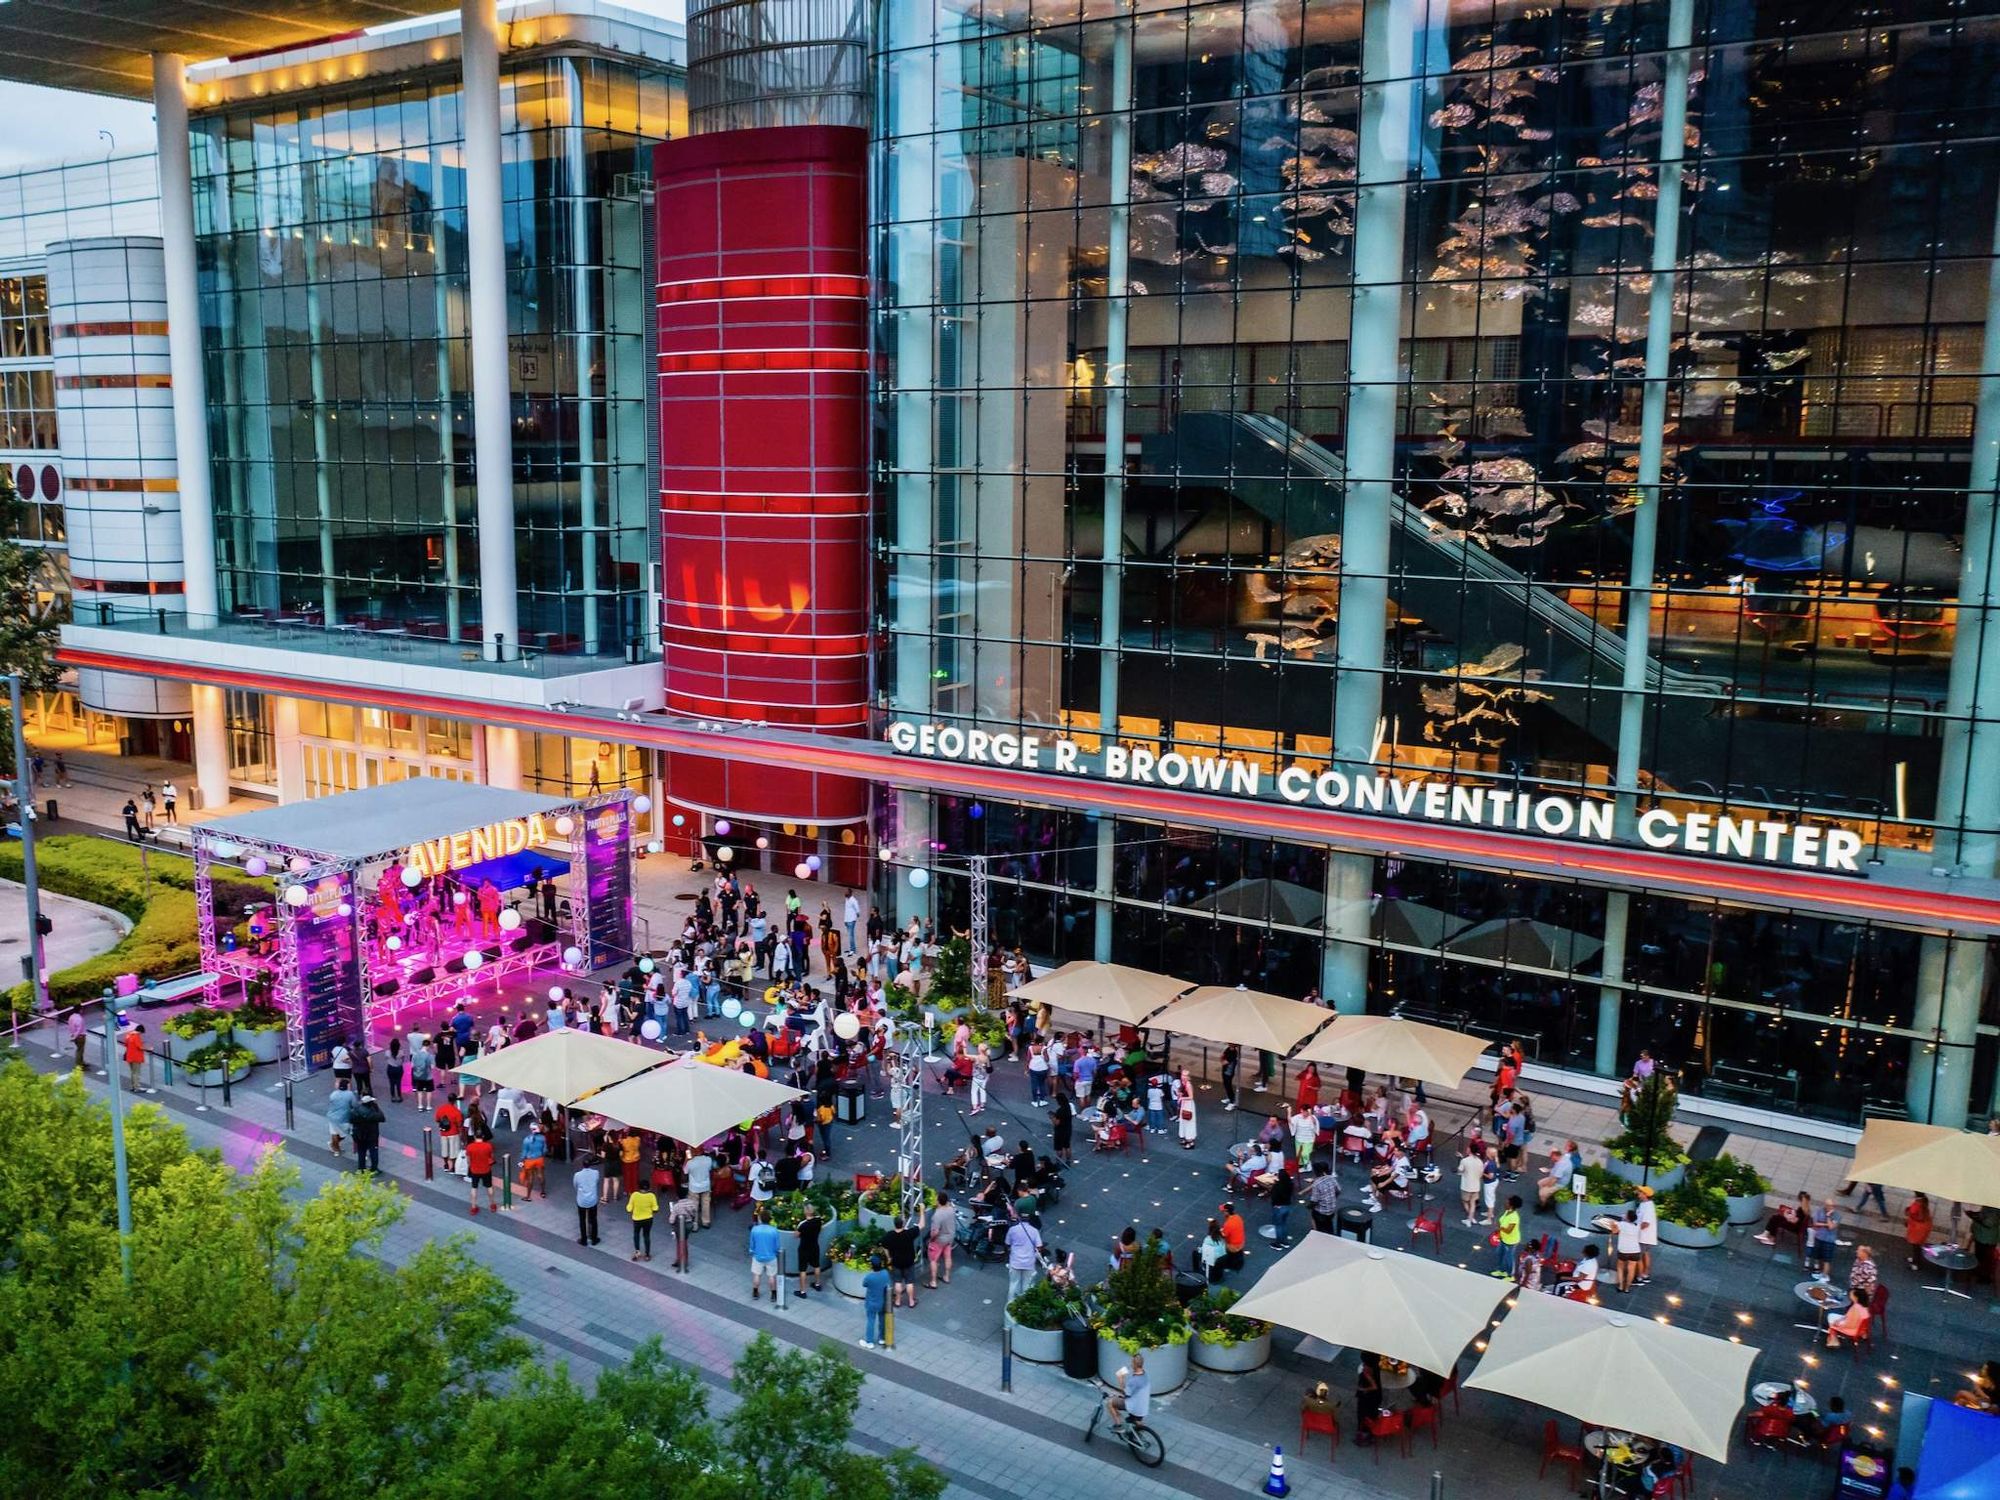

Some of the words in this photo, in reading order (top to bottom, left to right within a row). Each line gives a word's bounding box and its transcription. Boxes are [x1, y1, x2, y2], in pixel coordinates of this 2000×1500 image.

[890, 721, 1039, 769] GEORGE
[1055, 740, 1088, 774] R.
[1105, 745, 1259, 795] BROWN
[1278, 767, 1614, 840] CONVENTION
[1637, 808, 1862, 871] CENTER
[408, 812, 547, 878] AVENIDA
[328, 883, 352, 899] PLAZA
